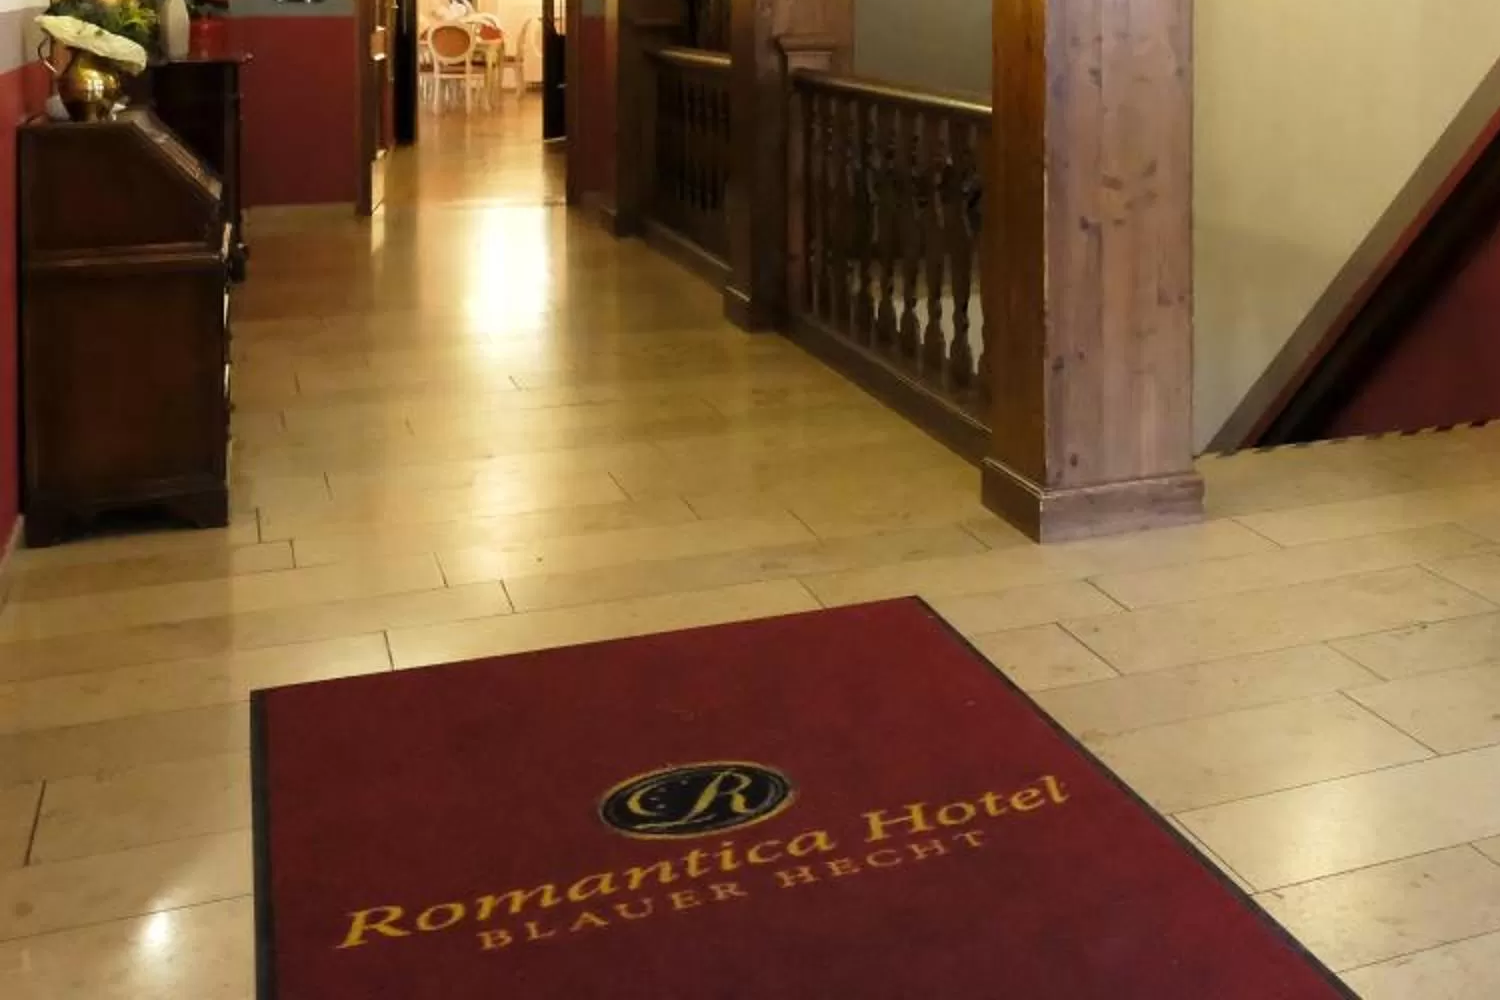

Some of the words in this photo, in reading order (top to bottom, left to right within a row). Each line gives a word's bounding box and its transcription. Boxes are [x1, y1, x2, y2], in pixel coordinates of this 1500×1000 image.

[335, 829, 837, 949] Romantica
[860, 775, 1070, 844] Hotel
[476, 882, 749, 951] BLAUER
[772, 830, 986, 889] HECHT
